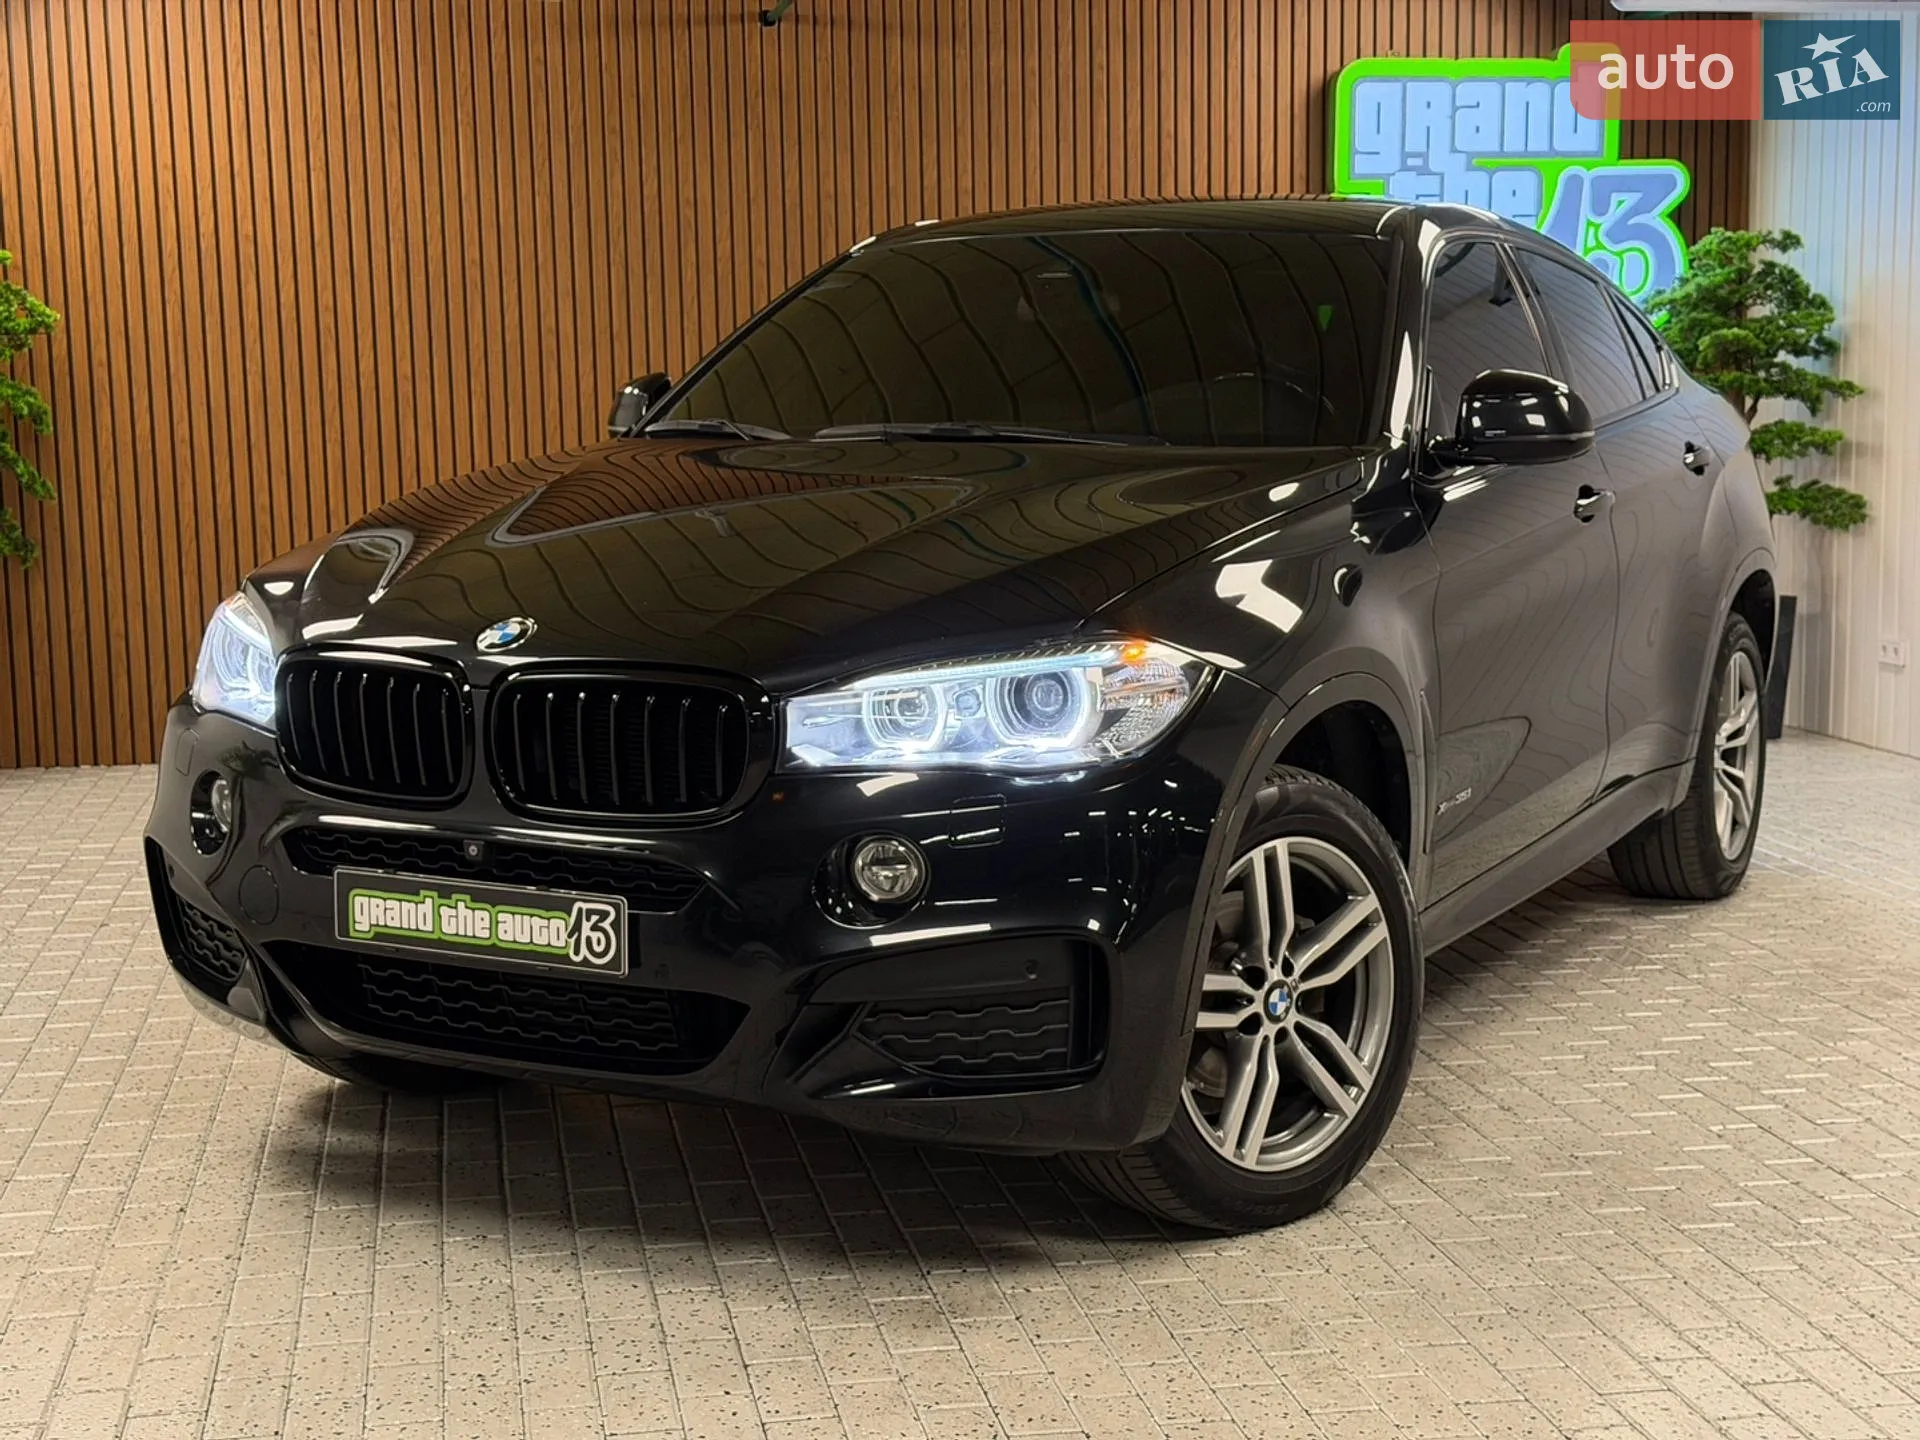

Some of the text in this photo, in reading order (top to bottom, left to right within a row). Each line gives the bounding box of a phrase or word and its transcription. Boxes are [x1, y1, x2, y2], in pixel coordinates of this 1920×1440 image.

[353, 894, 434, 932] grand
[439, 900, 492, 938] the
[496, 911, 567, 948] auto
